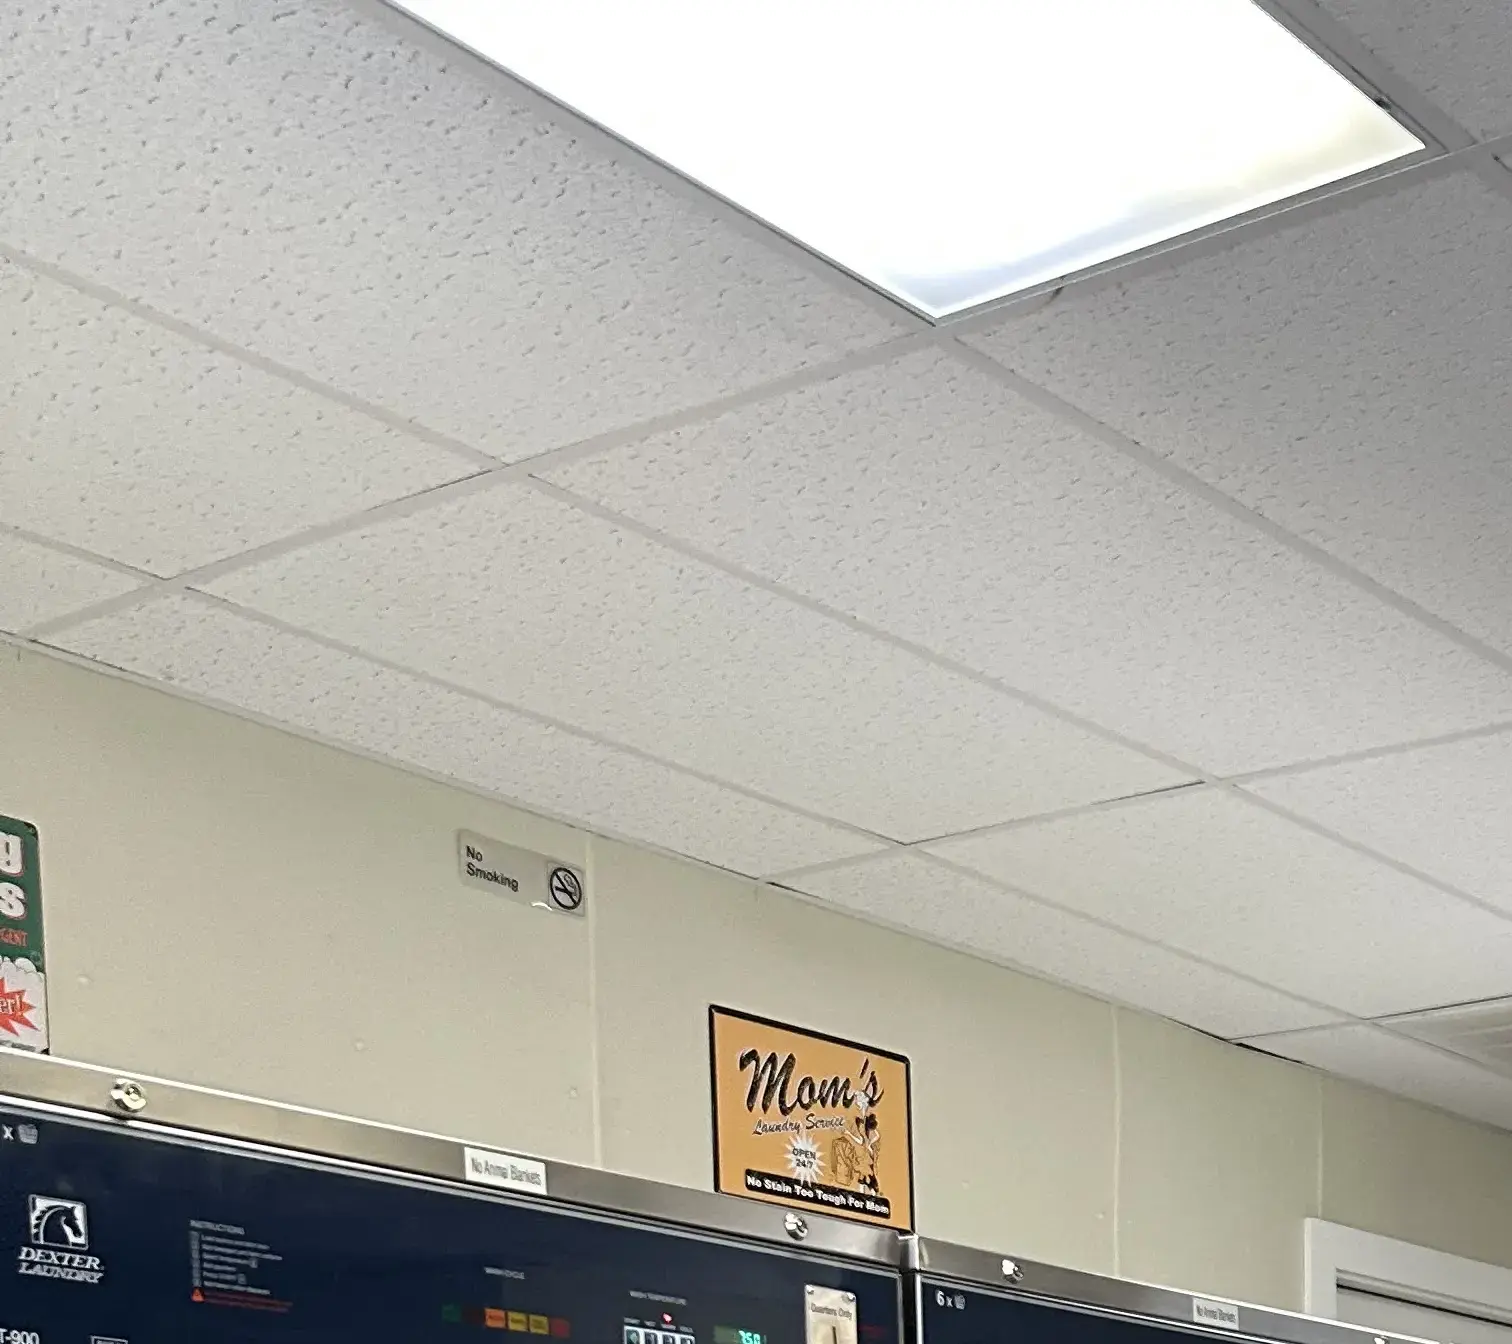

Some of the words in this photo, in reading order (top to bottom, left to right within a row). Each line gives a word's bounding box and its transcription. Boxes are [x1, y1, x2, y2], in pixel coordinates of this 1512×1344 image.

[466, 845, 483, 862] No
[466, 862, 519, 892] Smoking
[739, 1048, 885, 1117] Mom's
[752, 1119, 801, 1136] Laundry
[805, 1113, 844, 1130] Service
[471, 1157, 483, 1174] No
[792, 1148, 817, 1161] OPEN
[795, 1158, 814, 1169] 24/7
[746, 1175, 762, 1188] No
[764, 1178, 793, 1194] Stain
[794, 1184, 814, 1198] Too
[816, 1190, 847, 1206] Tough
[848, 1197, 865, 1209] For
[866, 1200, 890, 1215] Mom
[18, 1246, 101, 1270] DEXTER
[18, 1262, 104, 1284] LAUNDRY
